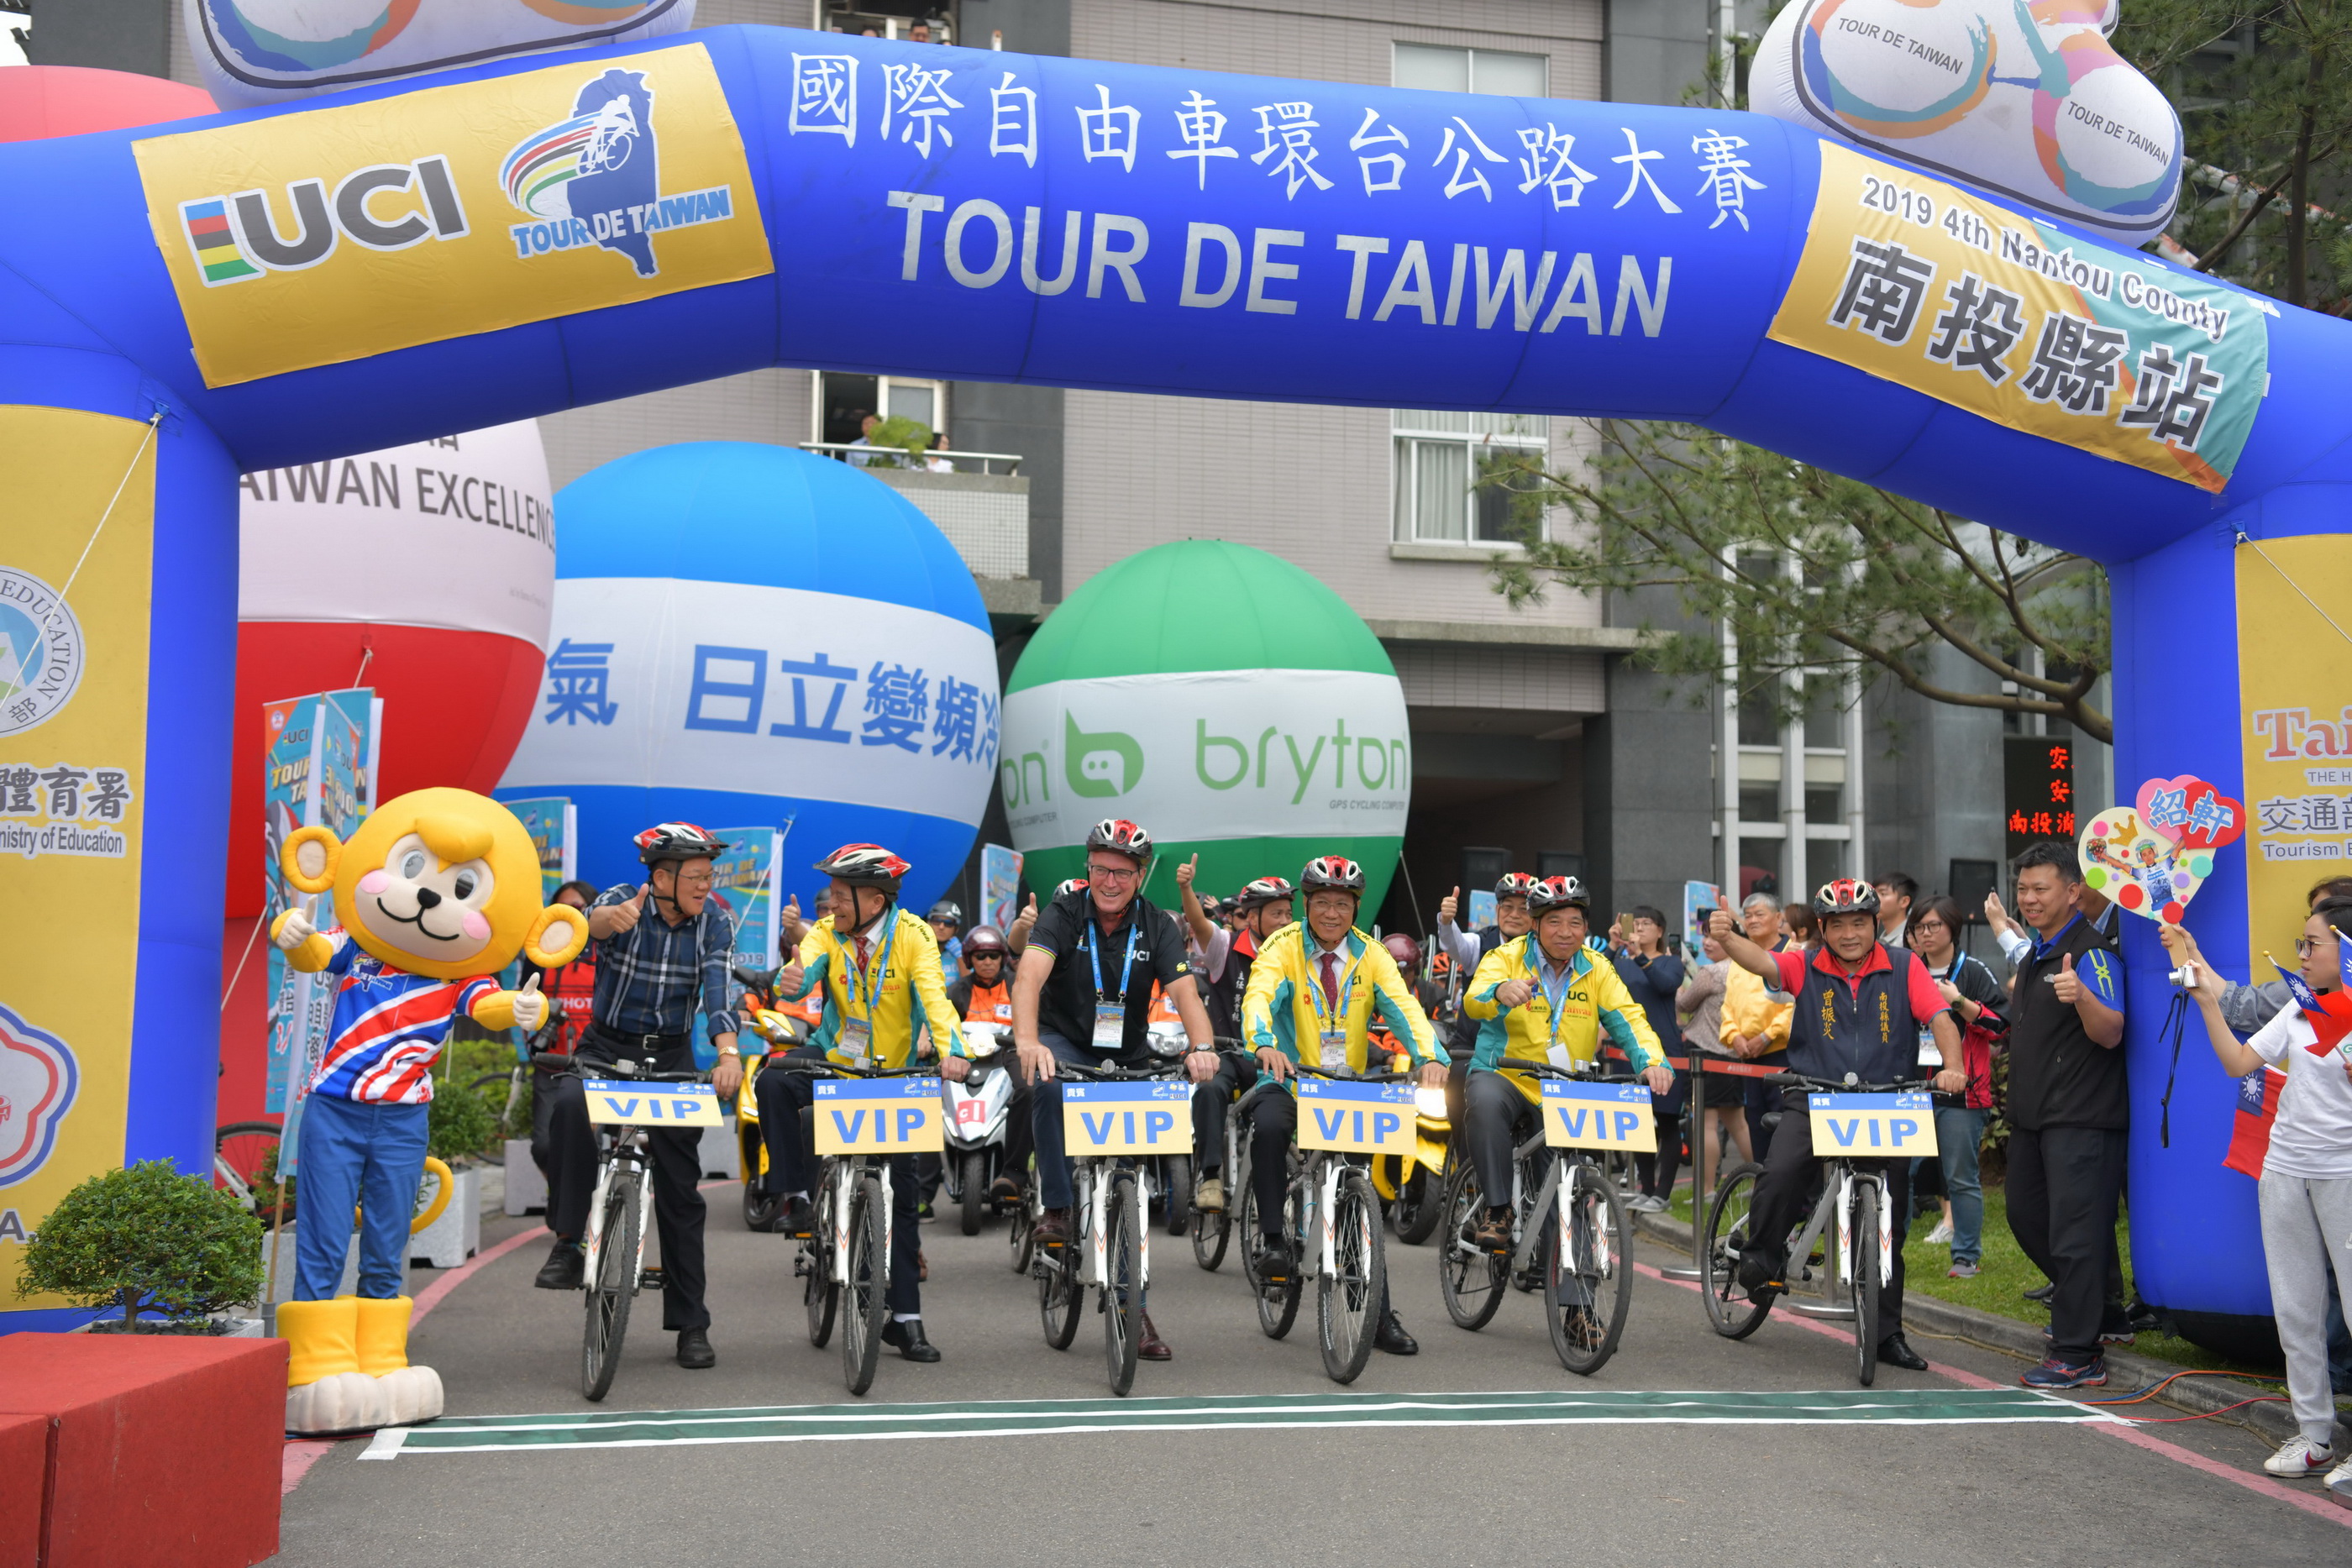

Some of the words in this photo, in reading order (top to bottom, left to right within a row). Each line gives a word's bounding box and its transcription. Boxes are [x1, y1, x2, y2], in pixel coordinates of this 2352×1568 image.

[1838, 17, 1881, 41] TOUR
[1882, 30, 1906, 50] DE
[1908, 39, 1963, 75] TAIWAN
[789, 52, 1767, 232] 國際自由車環台公路大賽
[2067, 101, 2103, 131] TOUR
[2103, 123, 2124, 139] DE
[2127, 129, 2169, 167] TAIWAN
[234, 159, 465, 266] UCI
[515, 217, 590, 255] TOUR
[597, 213, 628, 240] DE
[628, 189, 730, 233] TAIWAN
[887, 191, 1150, 303] TOUR
[1179, 222, 1305, 315] DE
[1336, 234, 1672, 338] TAIWAN
[1863, 177, 1933, 225] 2019
[1944, 207, 1990, 251] 4th
[2002, 228, 2111, 296] Nantou
[2124, 271, 2229, 339] County
[1833, 240, 2223, 449] 南投縣站
[1, 578, 71, 700] EDUCATION
[545, 638, 619, 726] 氣
[1195, 718, 1406, 805] bryton
[2308, 771, 2336, 783] THE
[1330, 800, 1348, 810] GPS
[2149, 788, 2233, 843] 紹軒
[42, 826, 56, 845] of
[58, 826, 123, 853] Education
[2263, 842, 2339, 857] Tourism
[604, 1097, 702, 1119] VIP
[831, 1108, 926, 1143] VIP
[1080, 1111, 1174, 1145] VIP
[1312, 1108, 1400, 1144] VIP
[1557, 1107, 1639, 1141] VIP
[1826, 1119, 1919, 1146] VIP
